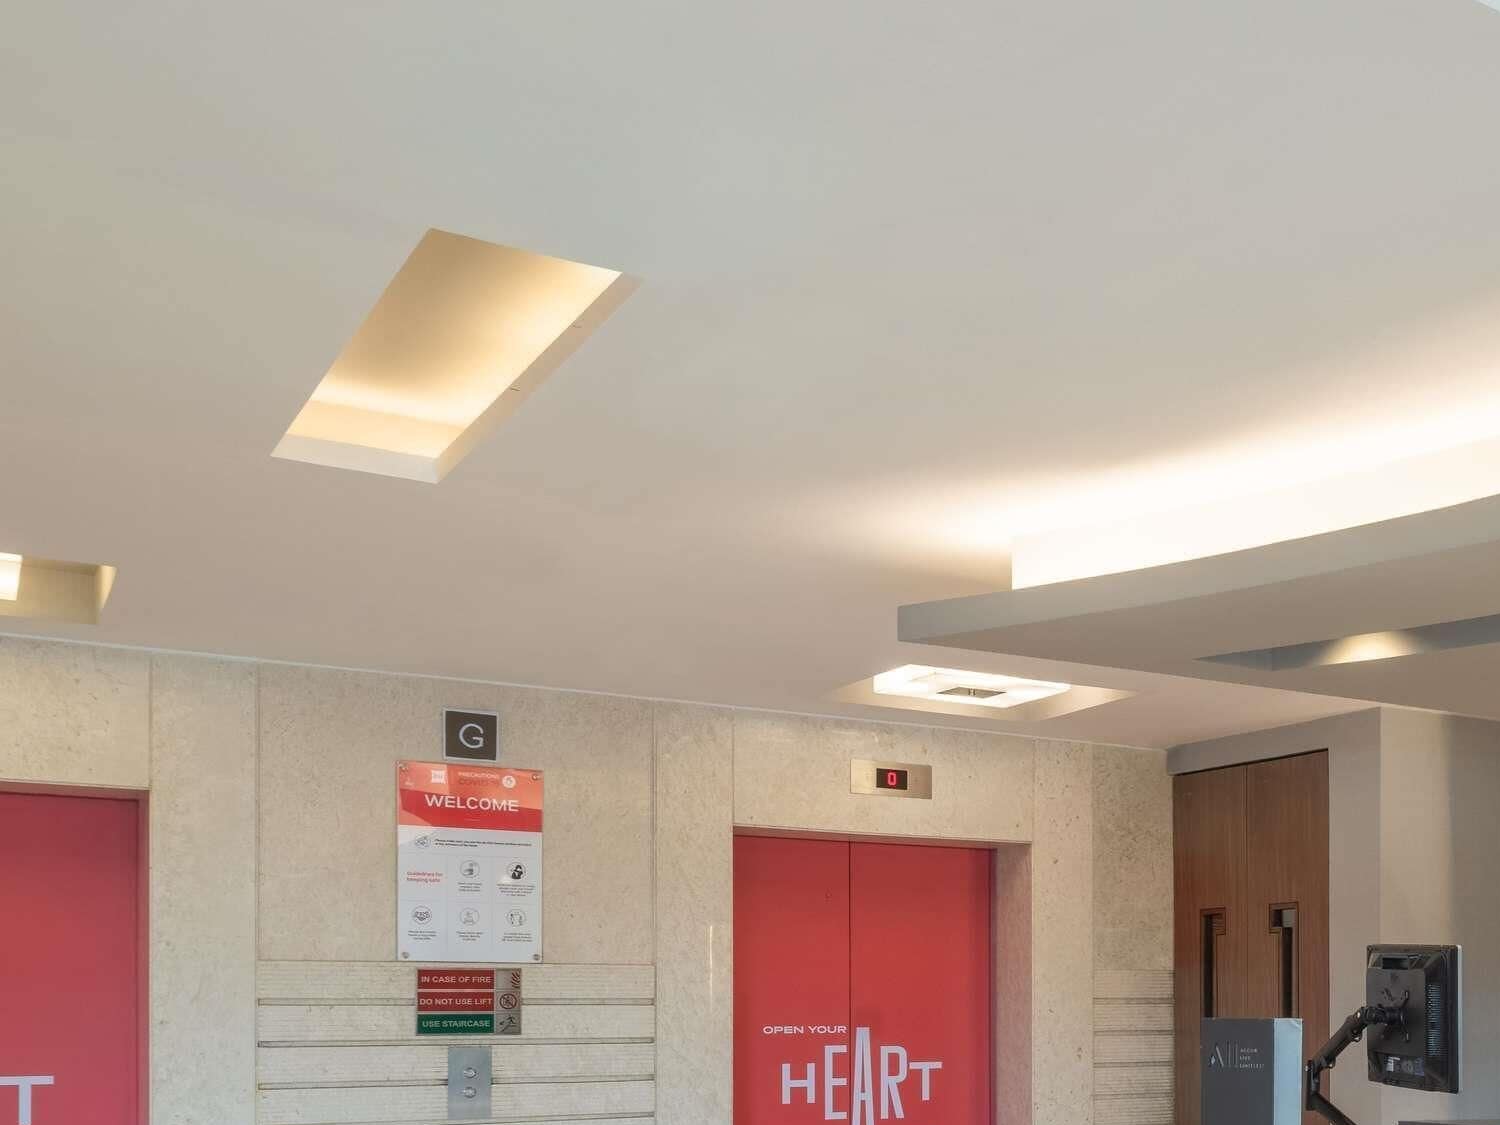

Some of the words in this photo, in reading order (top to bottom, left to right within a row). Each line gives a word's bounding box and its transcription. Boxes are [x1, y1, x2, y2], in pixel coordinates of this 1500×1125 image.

[459, 723, 484, 749] G
[424, 793, 520, 812] WELCOME
[763, 1026, 804, 1034] OPEN
[808, 1025, 847, 1034] YOUR
